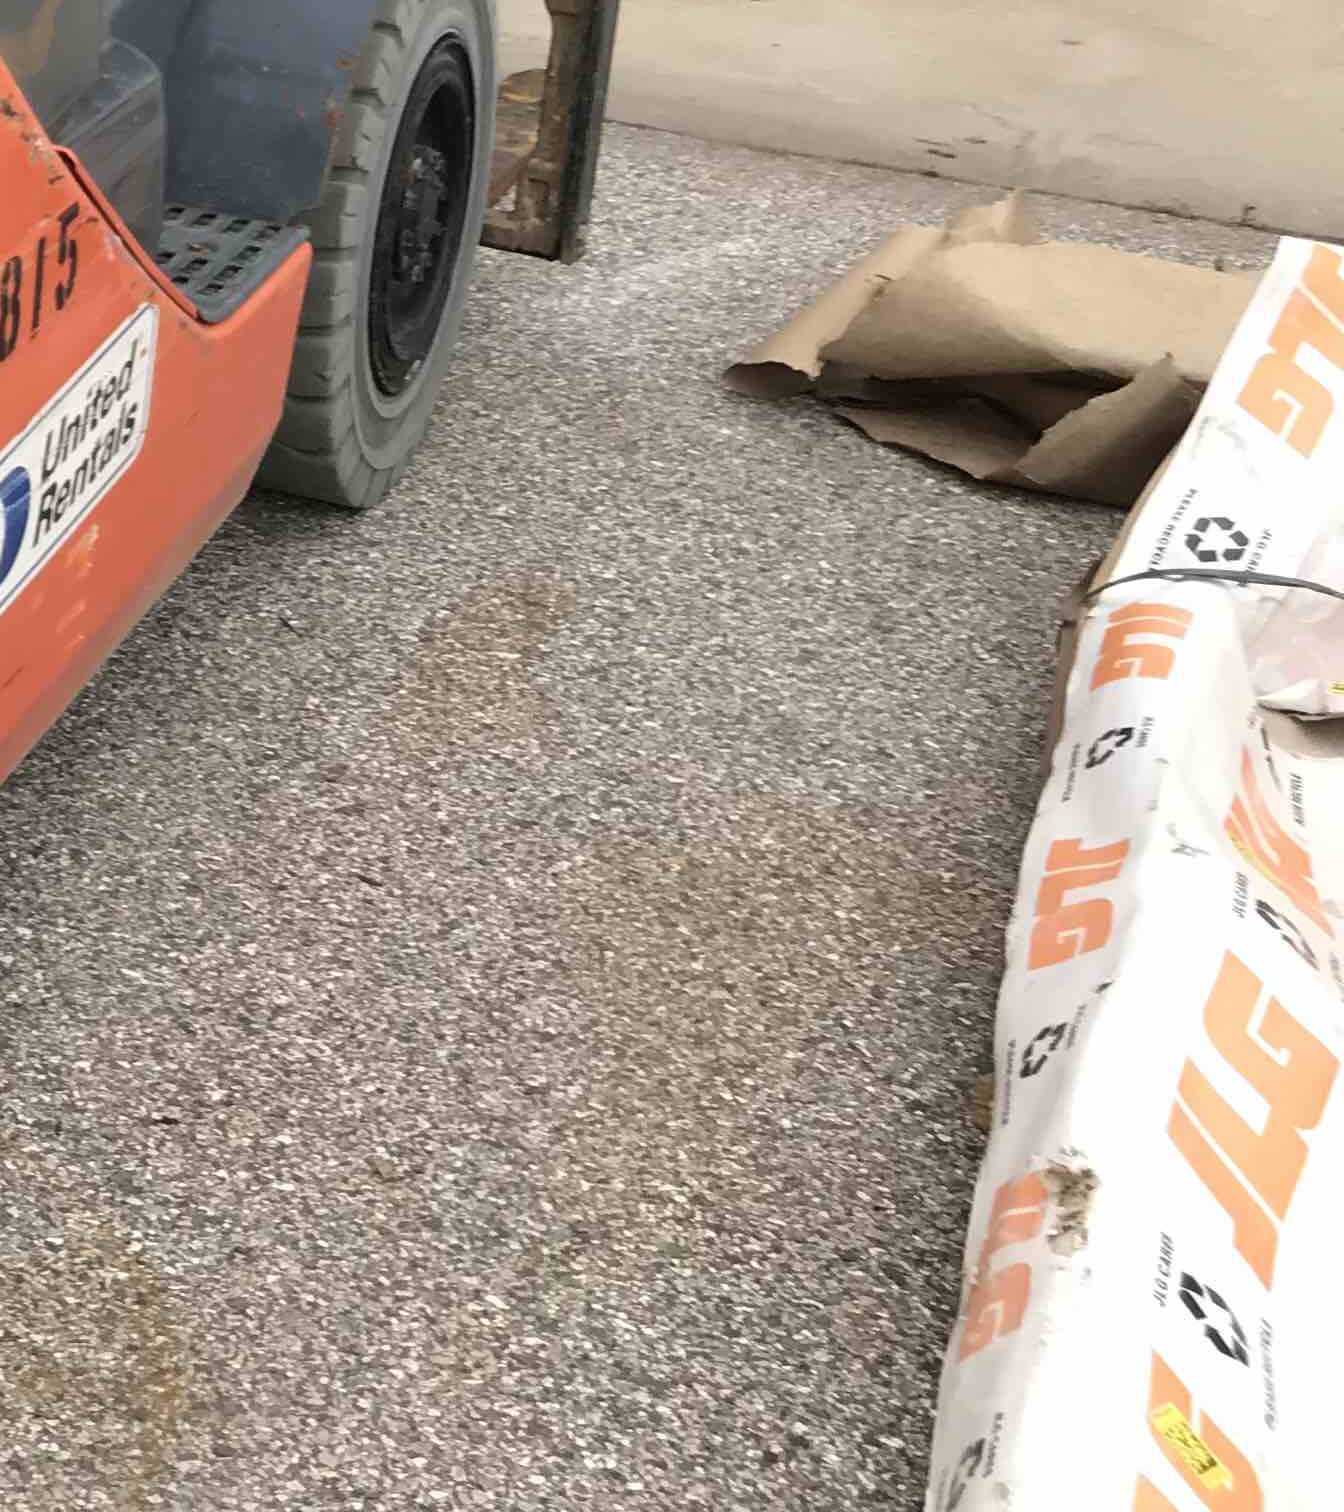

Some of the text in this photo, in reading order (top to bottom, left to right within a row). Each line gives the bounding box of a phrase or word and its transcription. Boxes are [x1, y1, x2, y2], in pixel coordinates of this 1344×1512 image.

[33, 399, 137, 548] Rentals
[40, 338, 138, 480] United
[1027, 838, 1131, 970] JLG
[1165, 948, 1342, 1292] JLG
